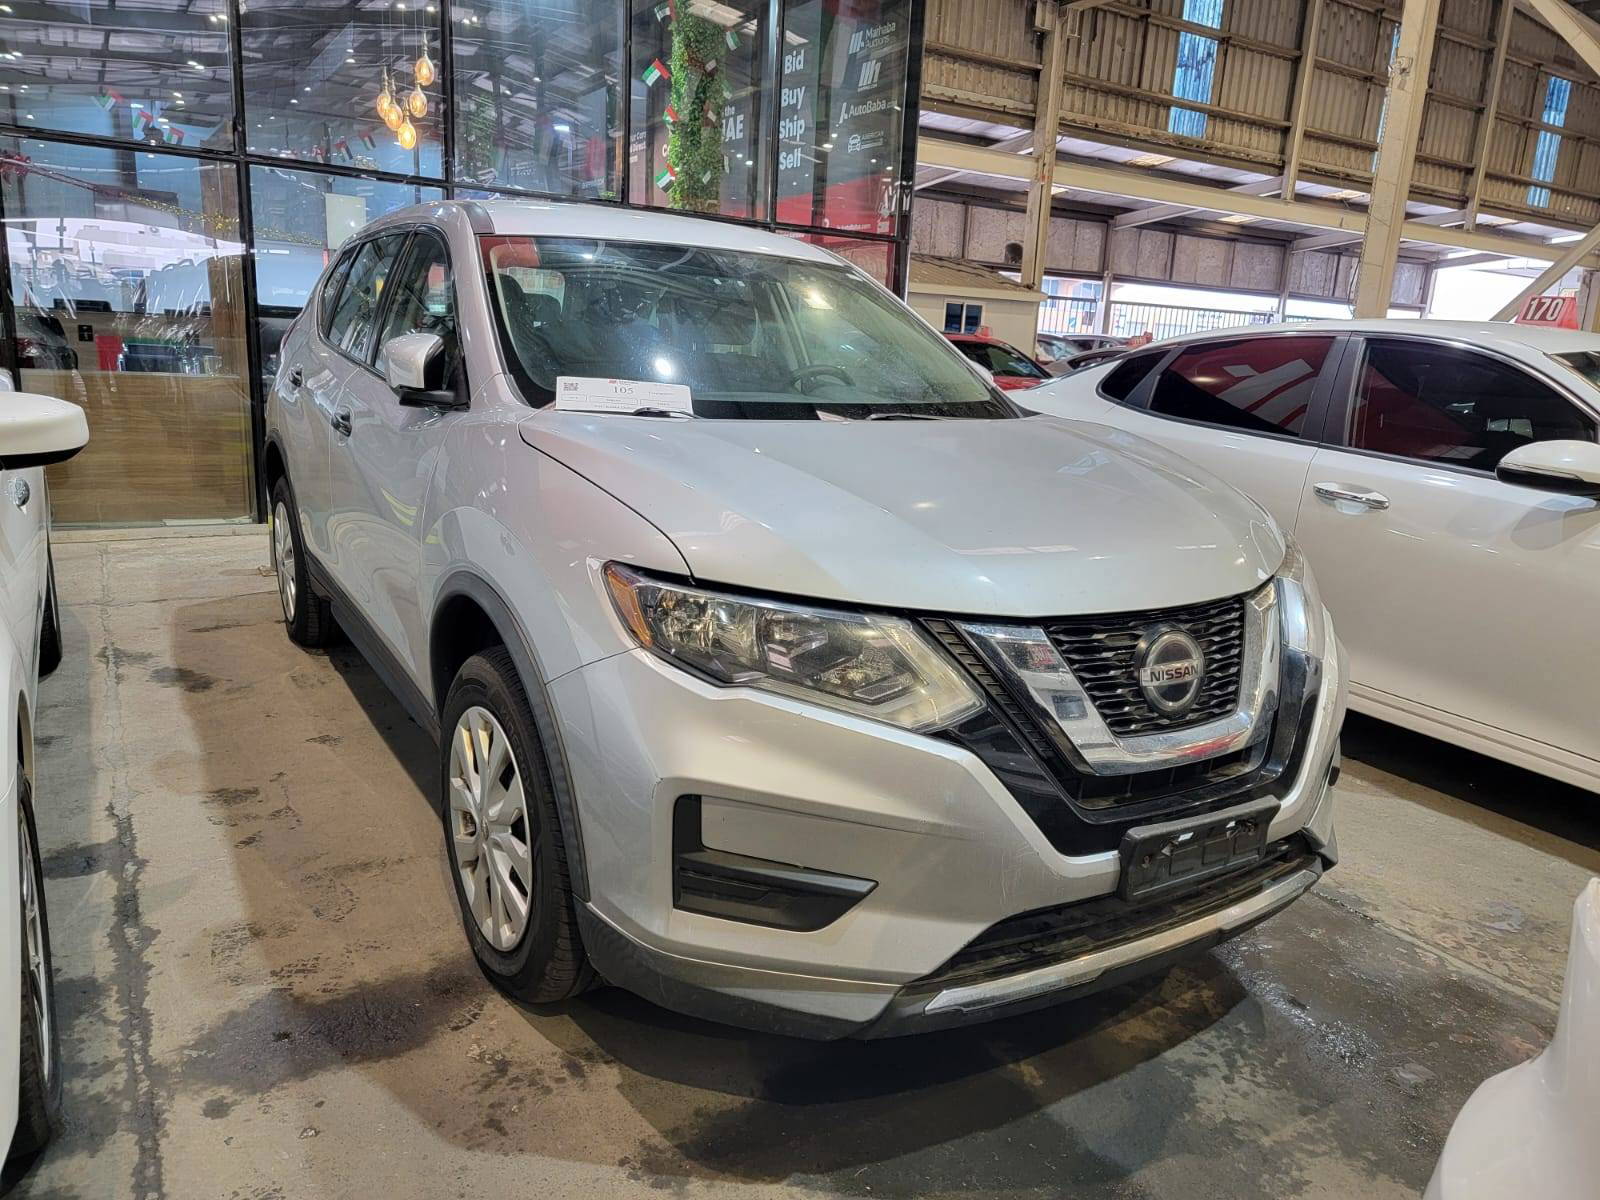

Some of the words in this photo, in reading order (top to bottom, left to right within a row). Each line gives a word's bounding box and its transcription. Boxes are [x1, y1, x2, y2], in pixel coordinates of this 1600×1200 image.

[784, 49, 805, 75] Bid
[781, 86, 806, 109] Buy
[779, 114, 805, 141] Ship
[779, 147, 802, 170] Sell
[1525, 297, 1565, 321] 170
[614, 385, 634, 395] 105
[1150, 663, 1199, 683] NISSAN
